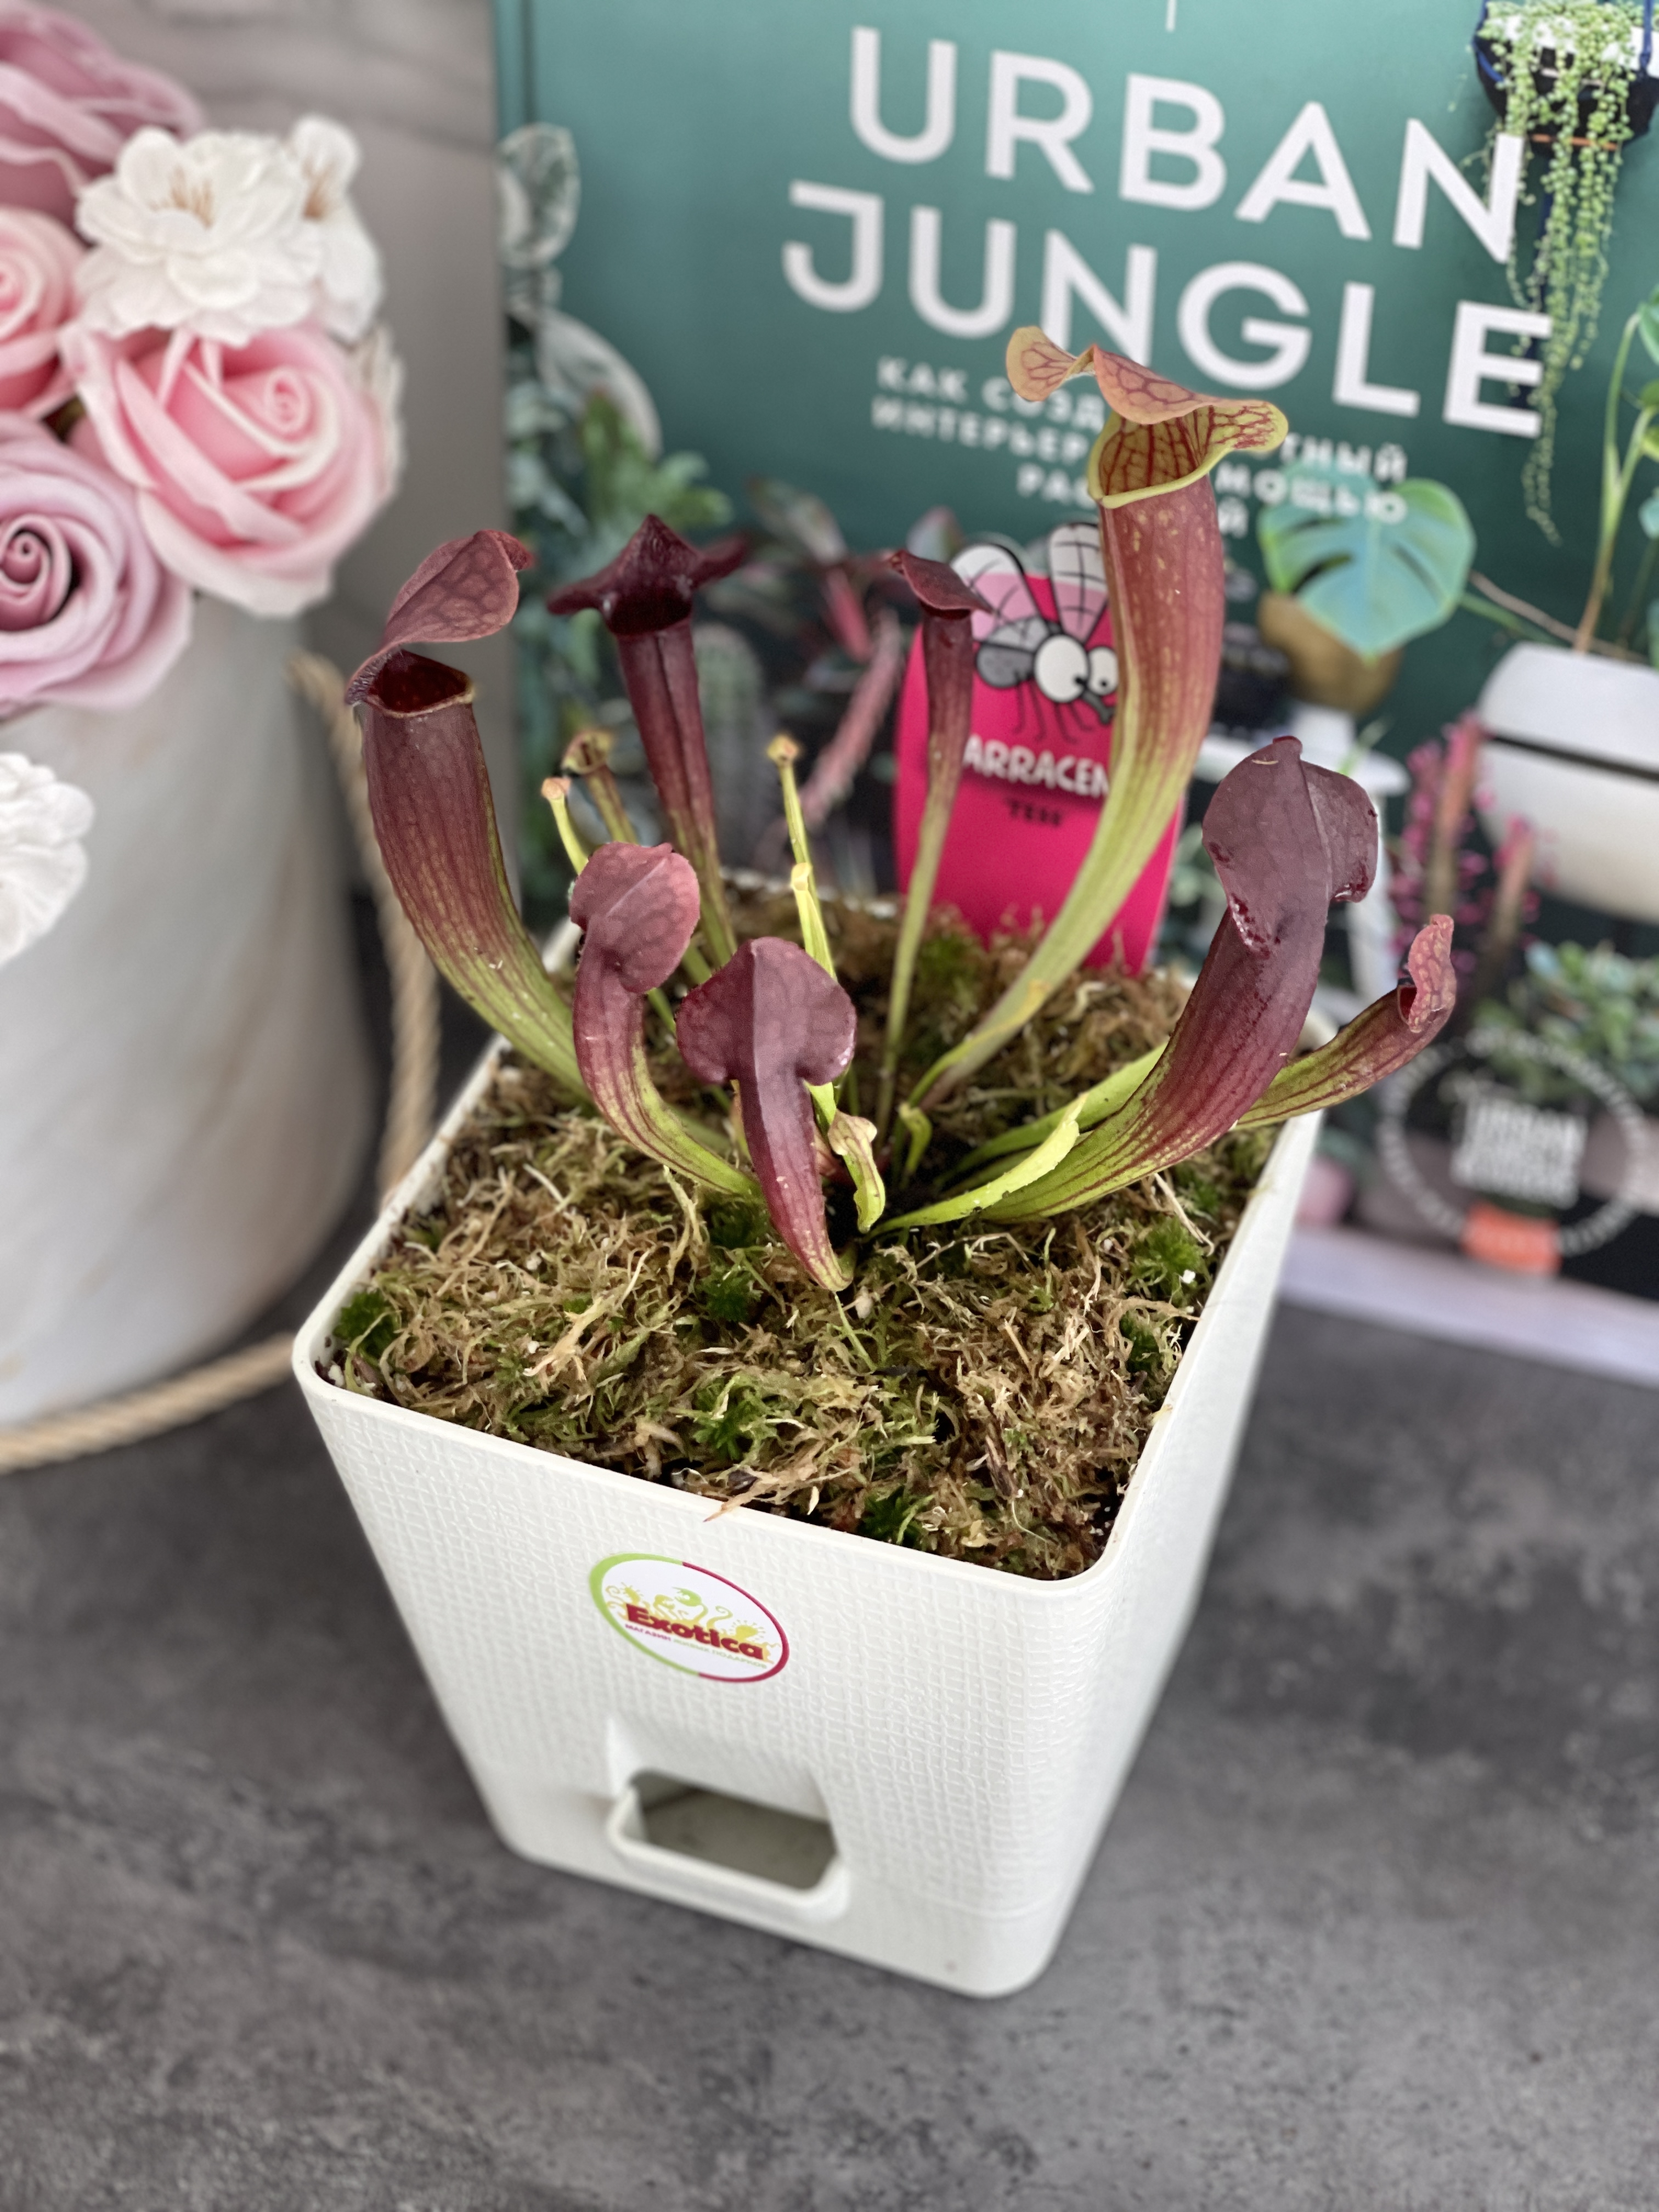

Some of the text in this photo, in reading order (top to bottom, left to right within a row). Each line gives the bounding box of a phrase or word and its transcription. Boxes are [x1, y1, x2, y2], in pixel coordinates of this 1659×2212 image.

[850, 26, 1524, 264] URBAN
[783, 180, 1553, 438] JUNGLE
[878, 355, 968, 404] КАК
[871, 395, 1407, 525] ИНТЕРЬЕР МОЩЬЮ
[963, 732, 1109, 799] ARRACEN
[626, 1603, 764, 1661] Exotica
